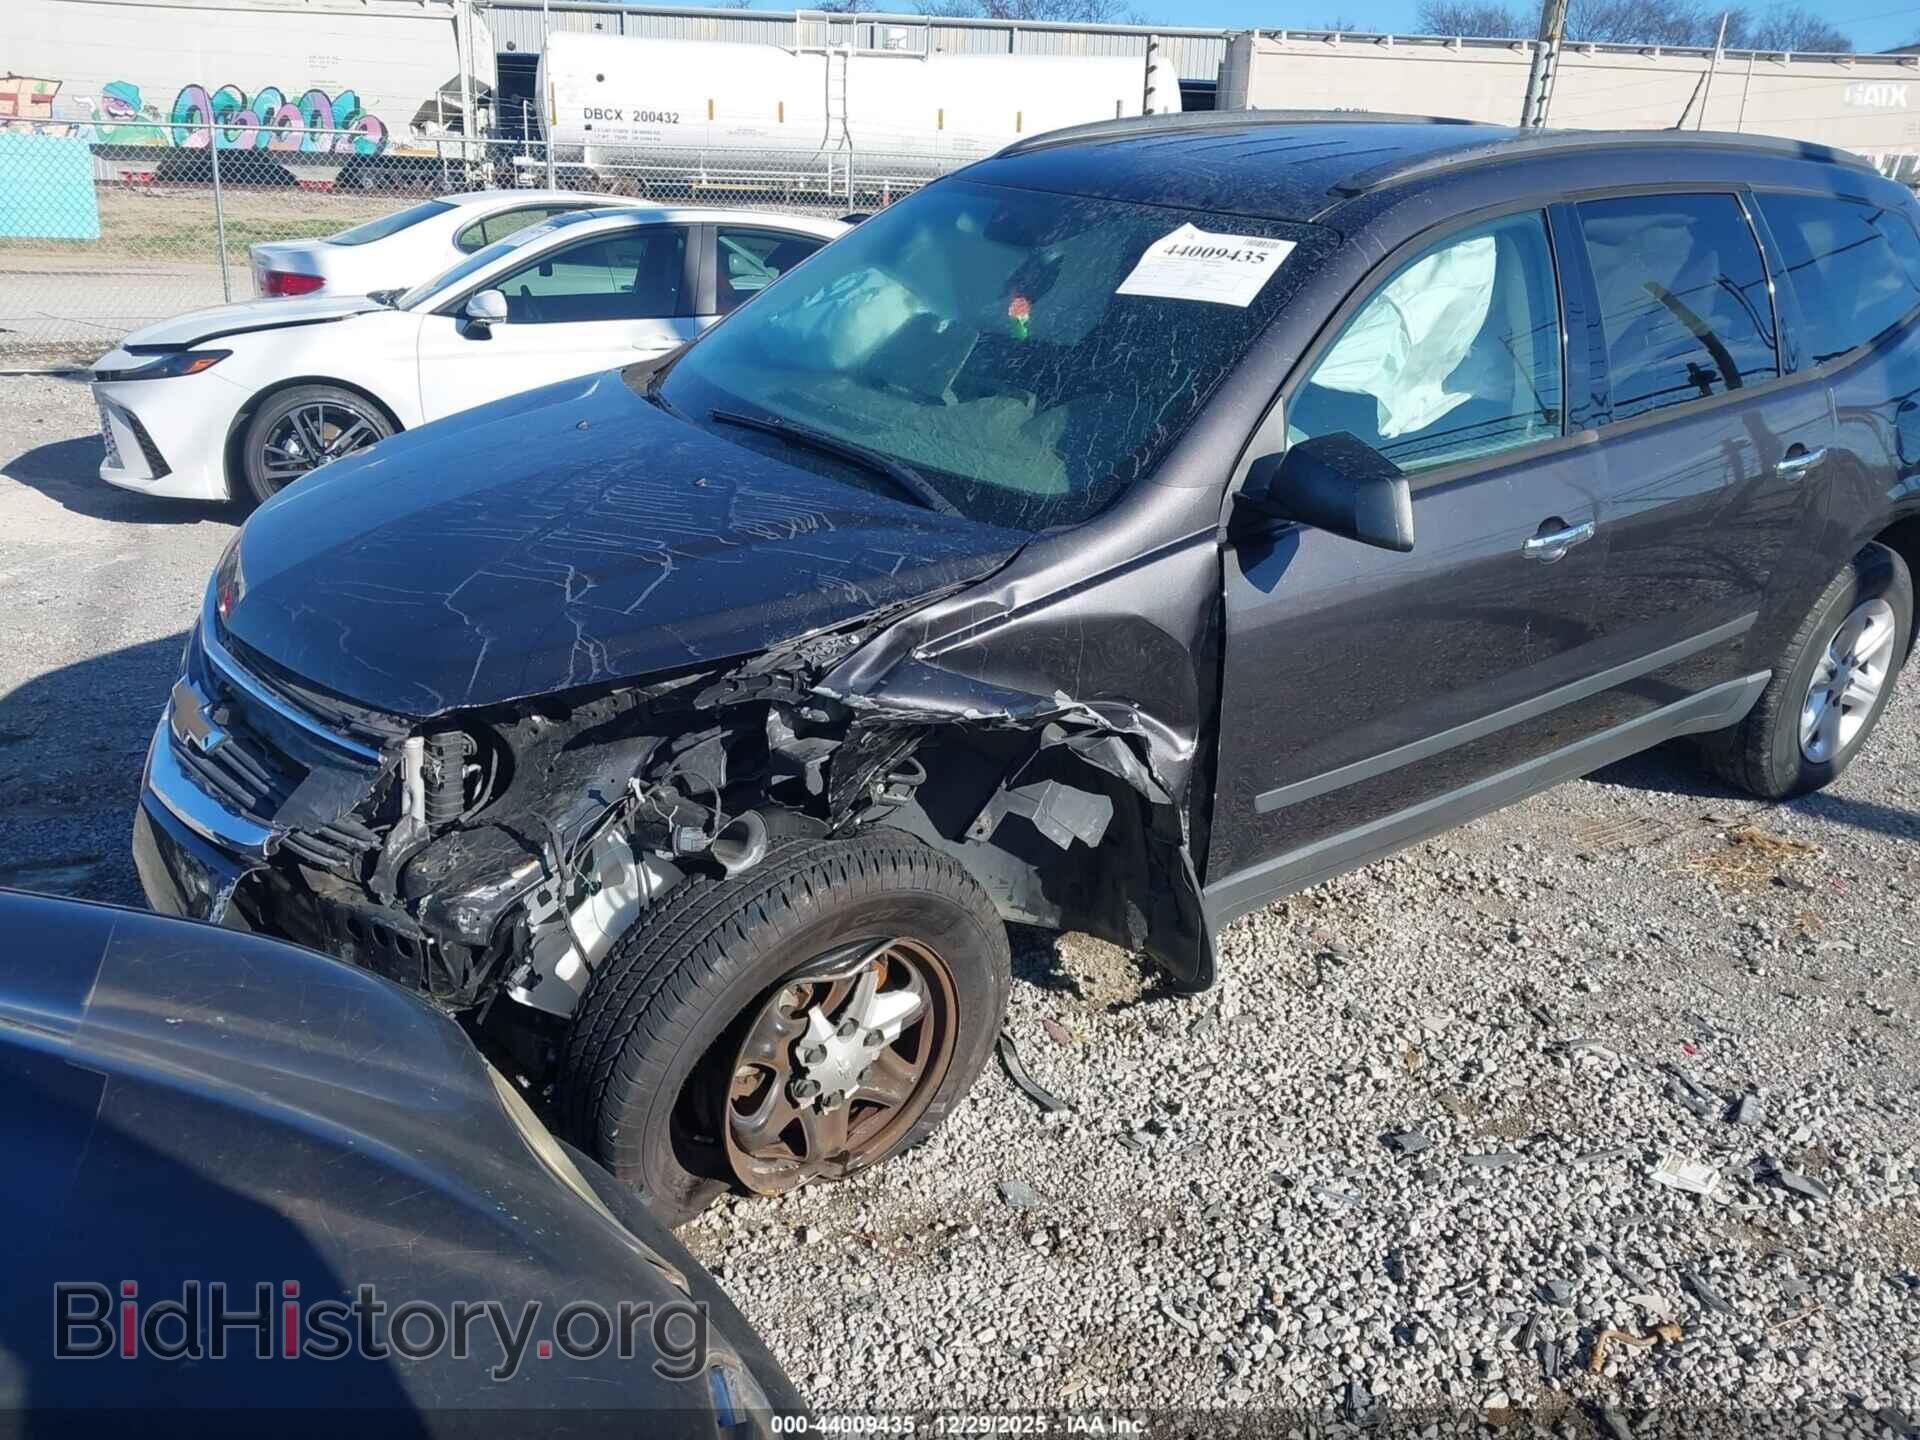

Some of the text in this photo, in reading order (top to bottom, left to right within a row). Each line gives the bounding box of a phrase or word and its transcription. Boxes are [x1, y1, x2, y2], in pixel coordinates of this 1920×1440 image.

[583, 107, 680, 124] DBCX 200432
[1163, 243, 1270, 265] 44009435
